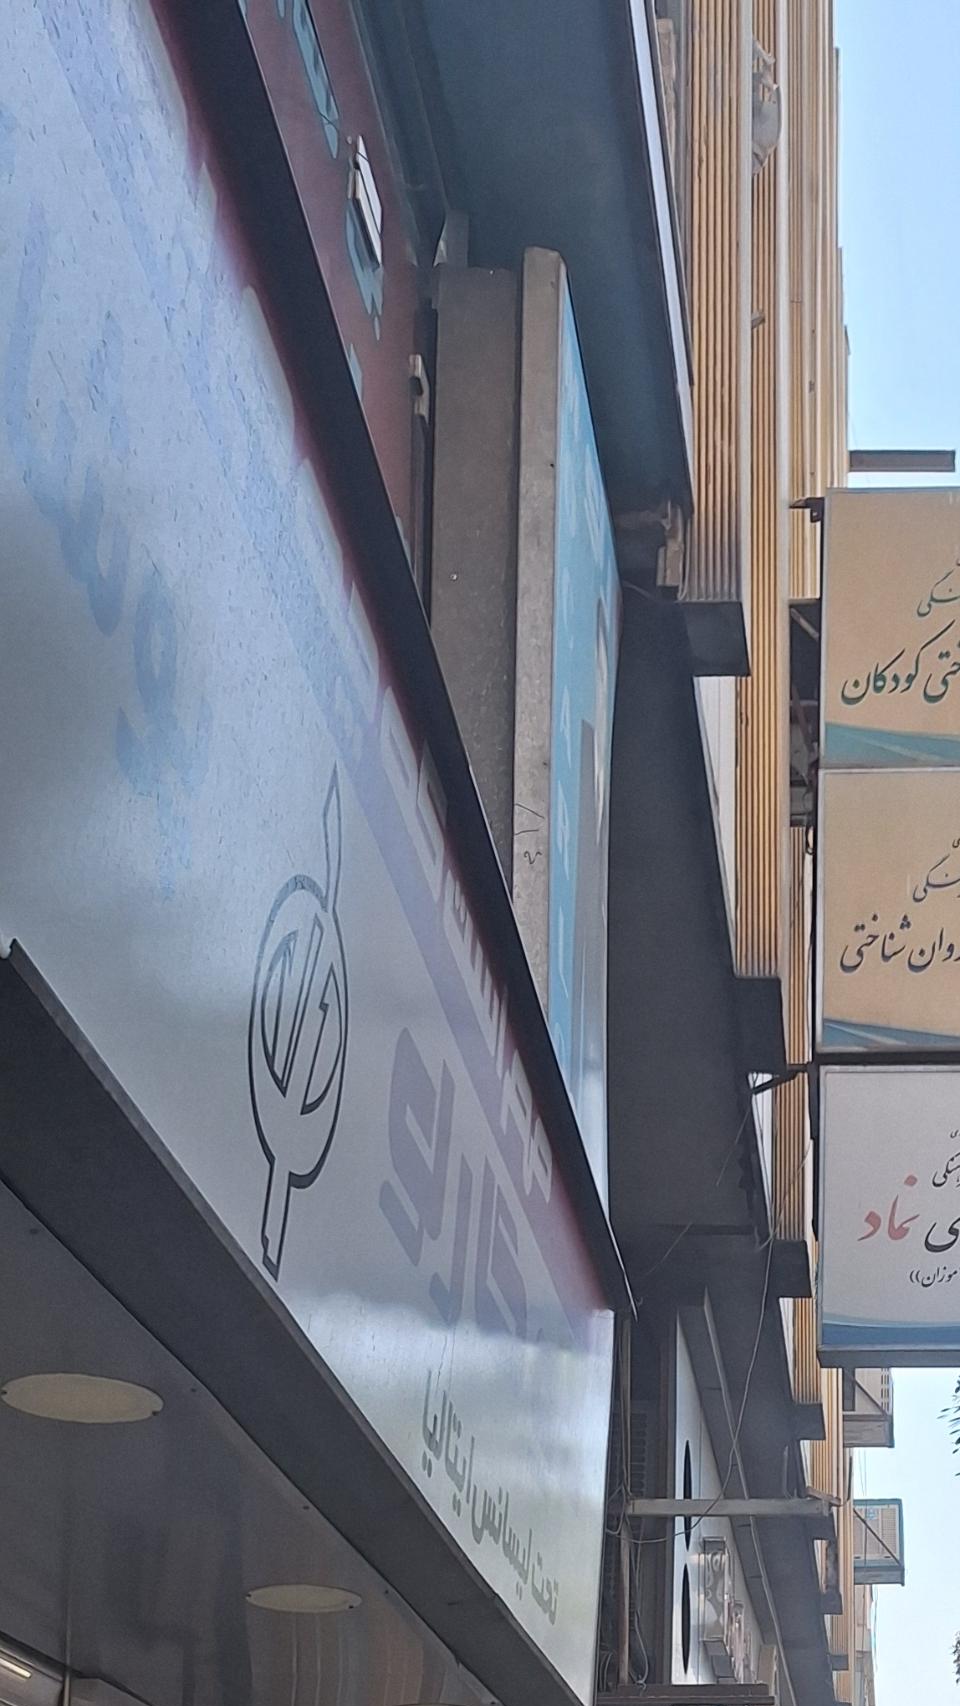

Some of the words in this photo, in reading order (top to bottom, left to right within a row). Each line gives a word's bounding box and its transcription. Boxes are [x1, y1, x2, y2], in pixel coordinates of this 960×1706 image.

[841, 619, 956, 705] کودکان
[380, 686, 447, 905] که
[443, 864, 512, 1080] است
[839, 914, 911, 974] شناختی
[500, 1046, 553, 1205] مهم
[857, 1174, 920, 1241] نماد
[421, 1369, 475, 1518] ایتالیا
[471, 1484, 532, 1600] لیسانس
[532, 1551, 559, 1626] تحت
